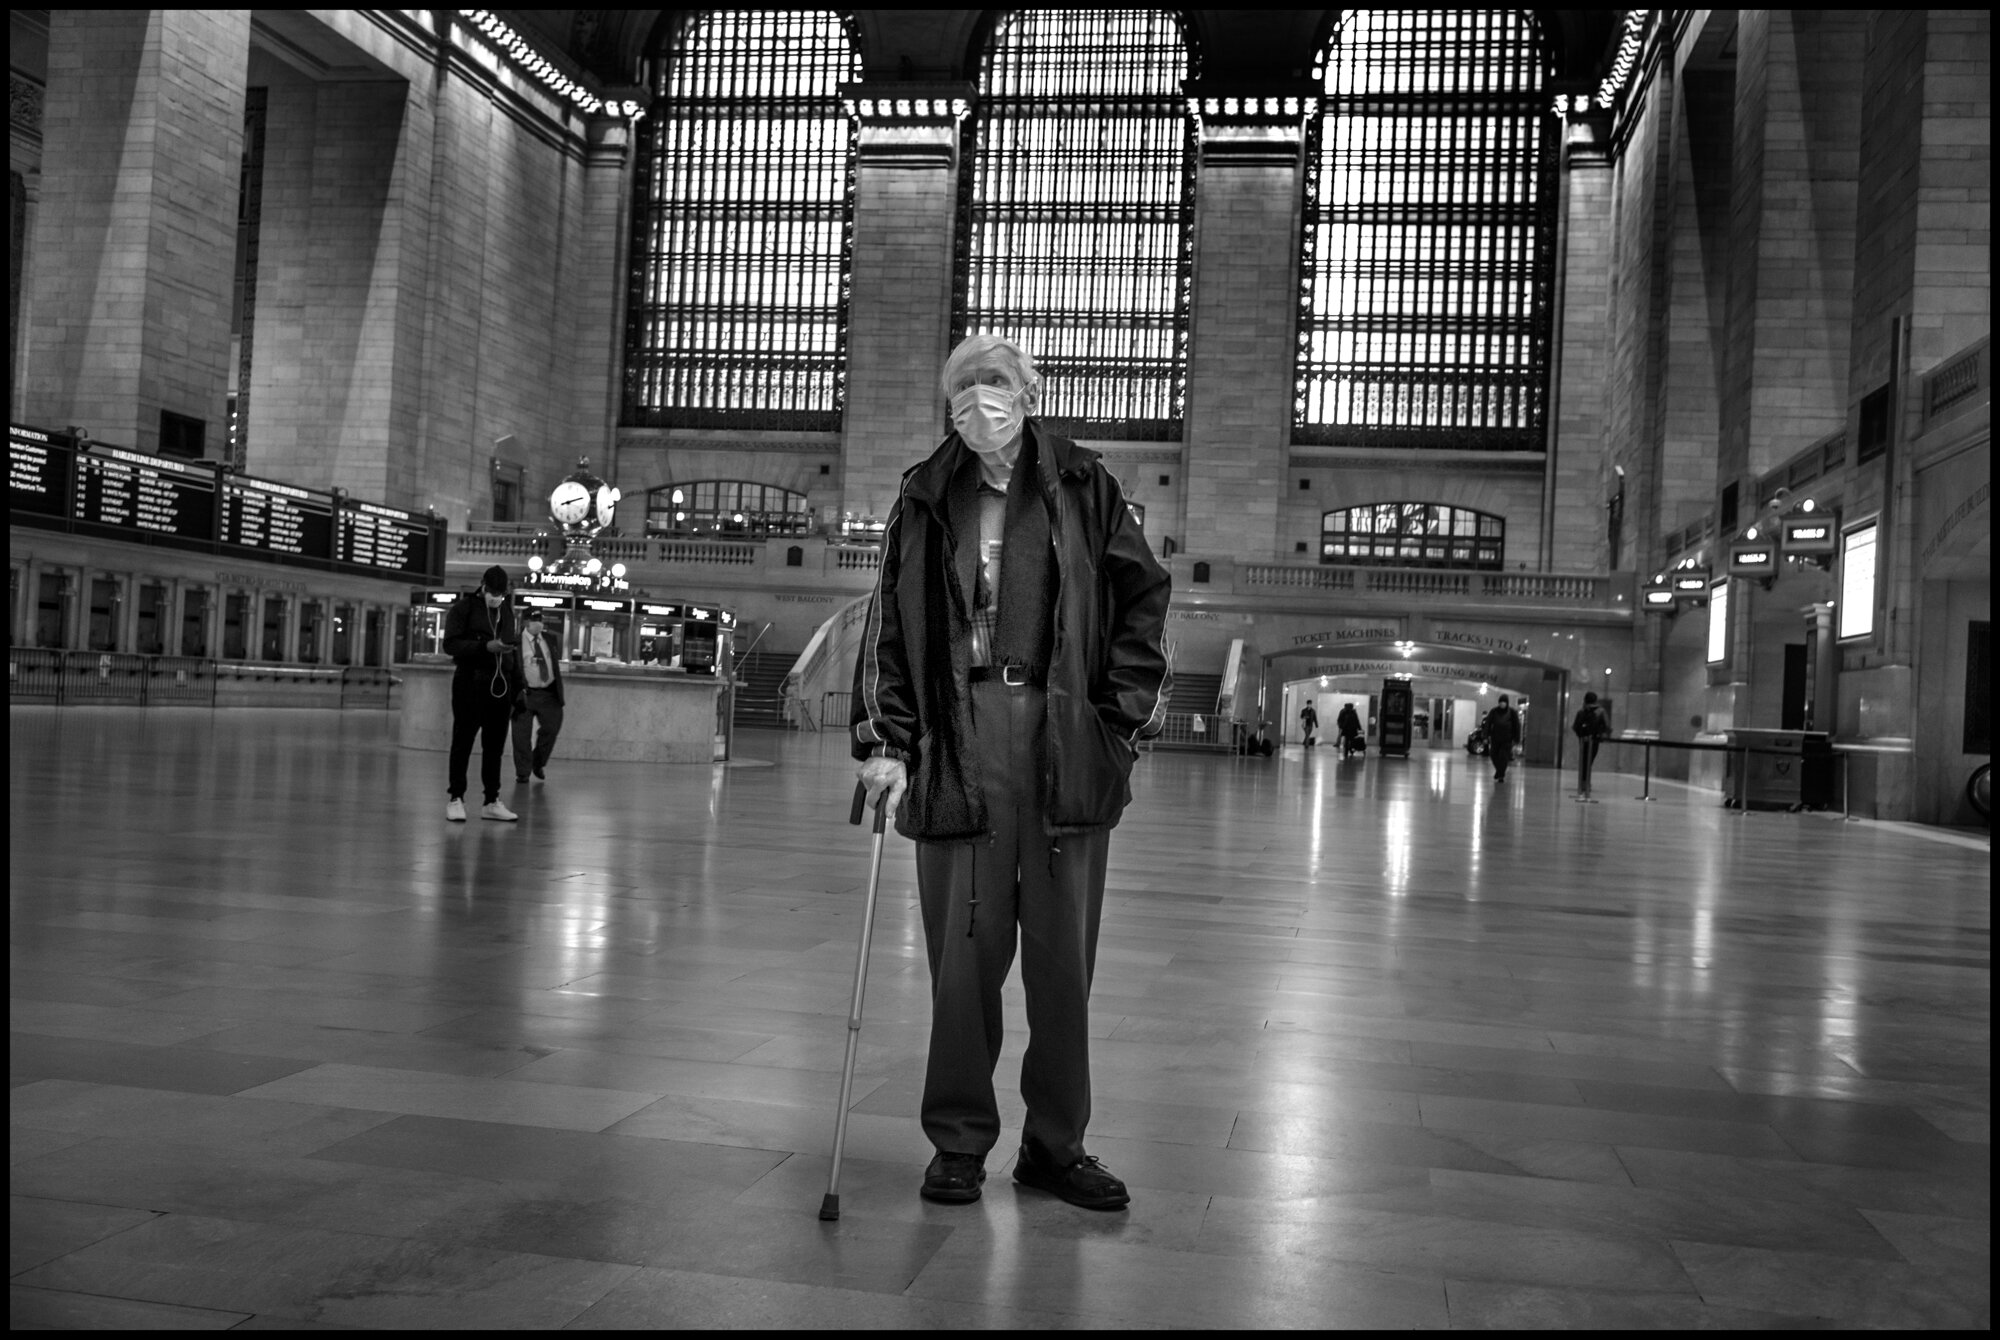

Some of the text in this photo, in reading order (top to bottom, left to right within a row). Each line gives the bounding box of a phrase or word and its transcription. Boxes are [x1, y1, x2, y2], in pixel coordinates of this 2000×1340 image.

[10, 426, 48, 442] NFORMATION
[541, 572, 591, 586] Information
[774, 594, 833, 604] WEST BALCONY
[1180, 612, 1220, 621] BALCONY
[1292, 628, 1396, 645] TICKET MACHINES
[1435, 630, 1480, 644] TRACKS
[1495, 640, 1513, 651] TO
[1308, 661, 1394, 675] SHUTTLE PASSAGE
[1421, 664, 1498, 683] WAITING ROOM
